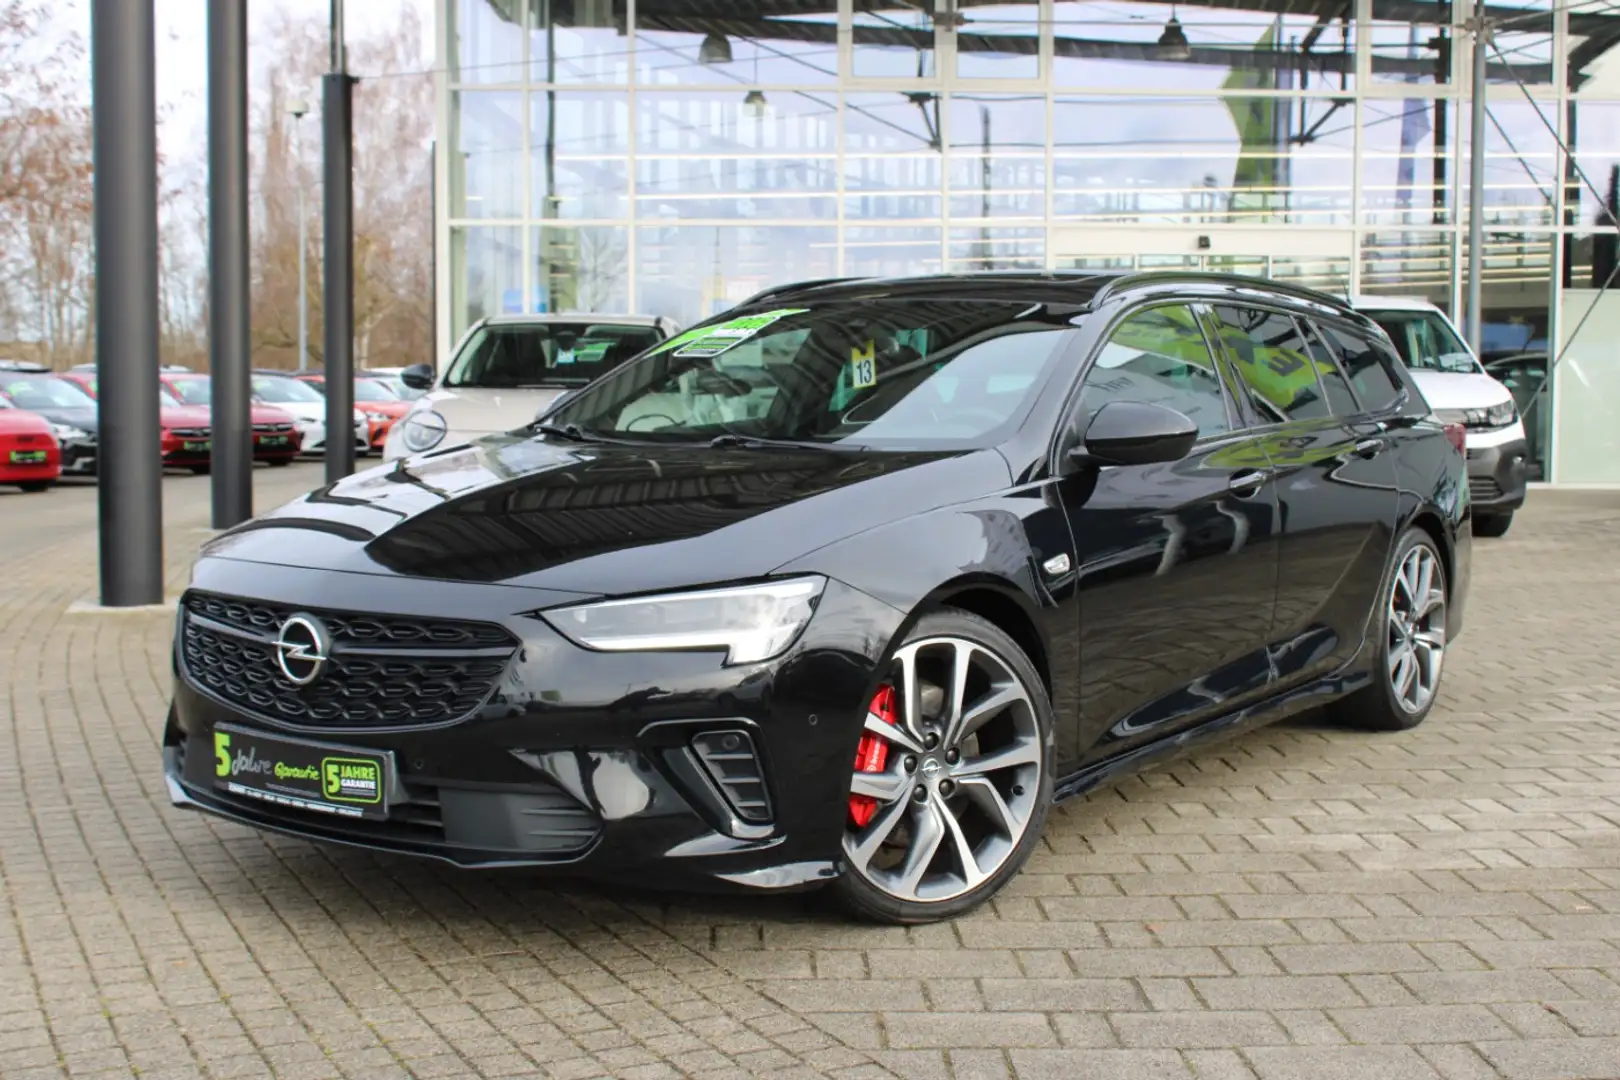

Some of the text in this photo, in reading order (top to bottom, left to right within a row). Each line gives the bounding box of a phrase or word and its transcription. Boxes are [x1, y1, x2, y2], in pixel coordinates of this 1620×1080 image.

[856, 360, 872, 384] 13
[214, 732, 231, 776] 5
[326, 764, 341, 794] 5
[340, 765, 376, 780] JAHRE
